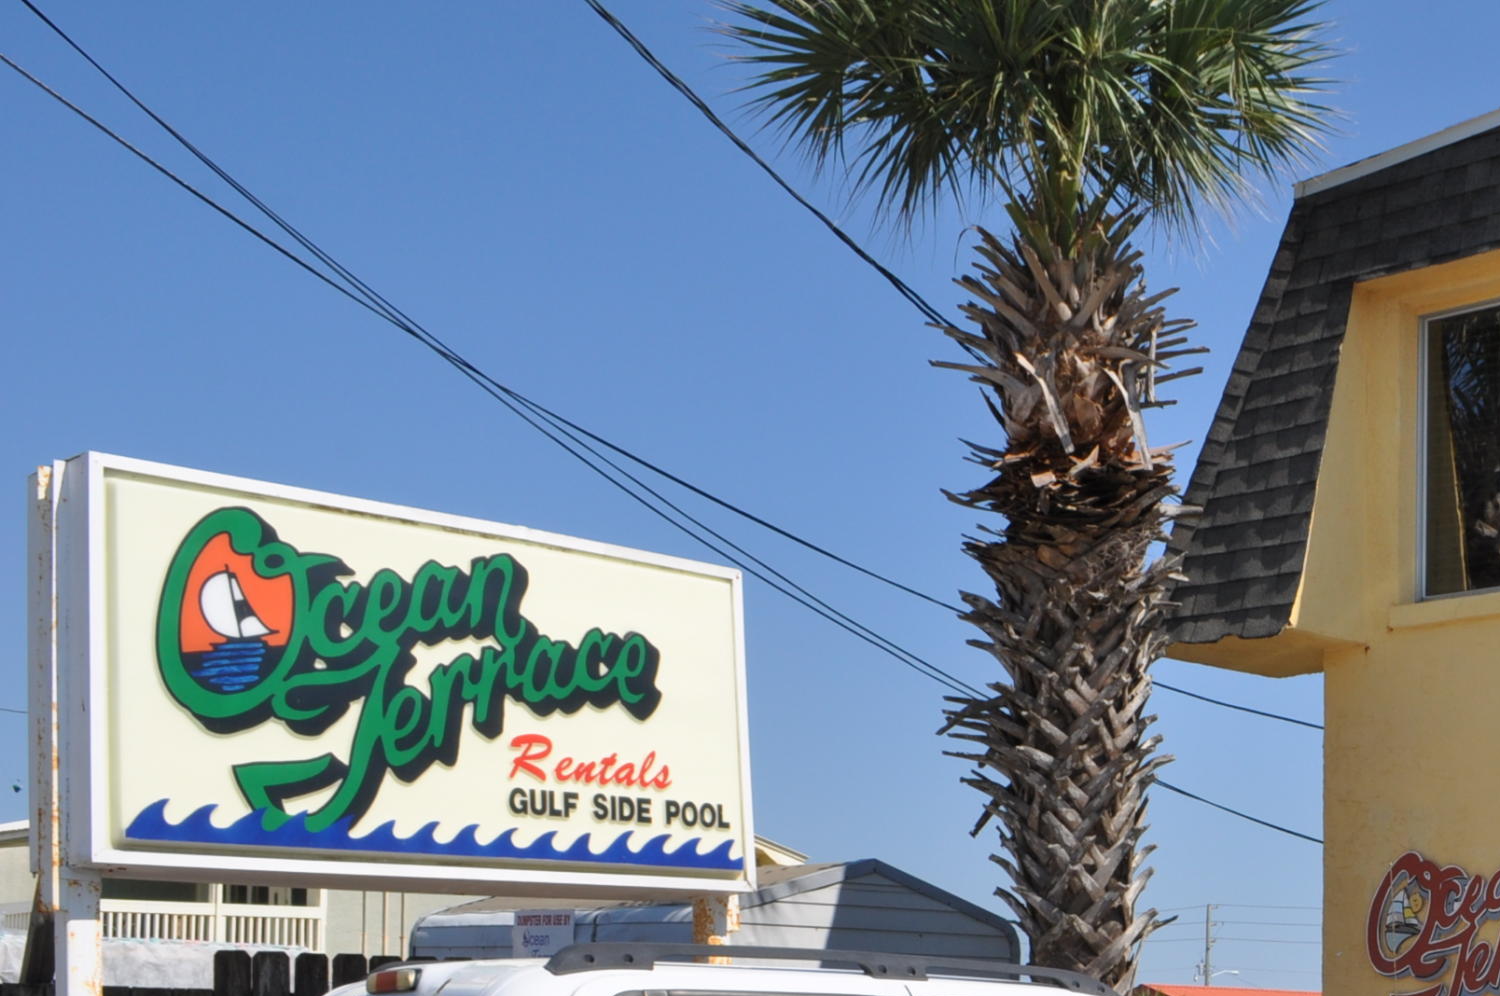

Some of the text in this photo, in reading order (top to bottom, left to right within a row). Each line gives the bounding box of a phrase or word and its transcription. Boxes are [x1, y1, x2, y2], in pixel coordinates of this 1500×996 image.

[155, 506, 528, 734] Ocean
[232, 628, 661, 832] Terrace
[510, 734, 672, 789] Rentals
[508, 787, 730, 829] GULF SIDE POOL
